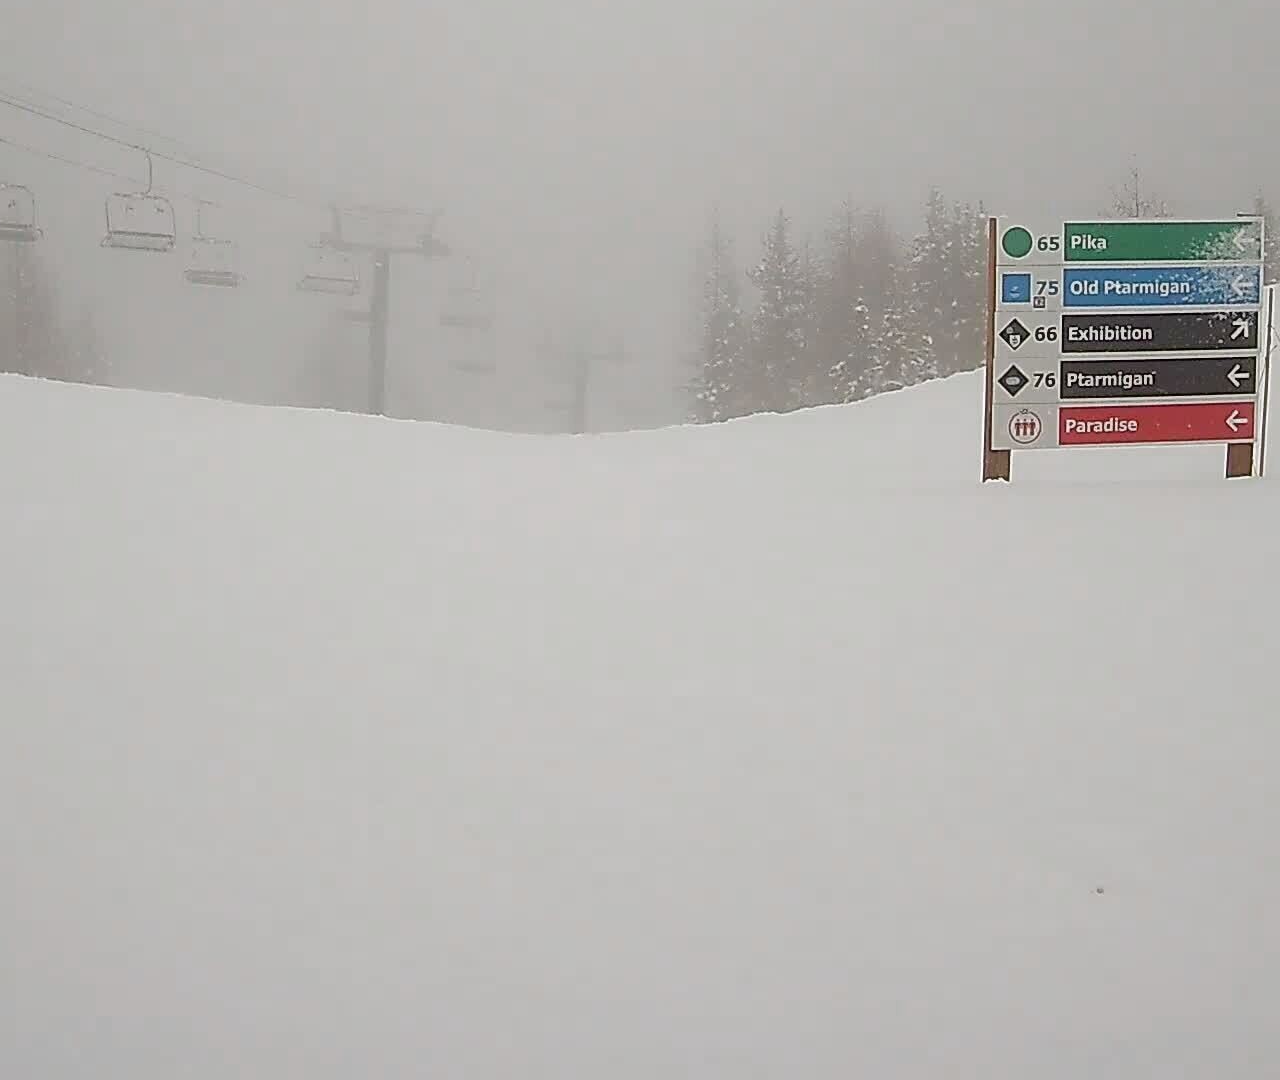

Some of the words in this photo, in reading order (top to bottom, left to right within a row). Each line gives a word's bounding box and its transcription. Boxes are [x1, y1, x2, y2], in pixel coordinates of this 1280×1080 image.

[1037, 236, 1060, 251] 65
[1070, 234, 1107, 250] Pika
[1036, 281, 1059, 295] 75
[1070, 279, 1099, 295] Old
[1103, 278, 1191, 299] Ptarmigan
[1034, 326, 1058, 342] 66
[1068, 324, 1153, 342] Exhibition
[1033, 372, 1056, 388] 76
[1066, 370, 1154, 390] Ptarmigan
[1065, 417, 1138, 434] Paradise
